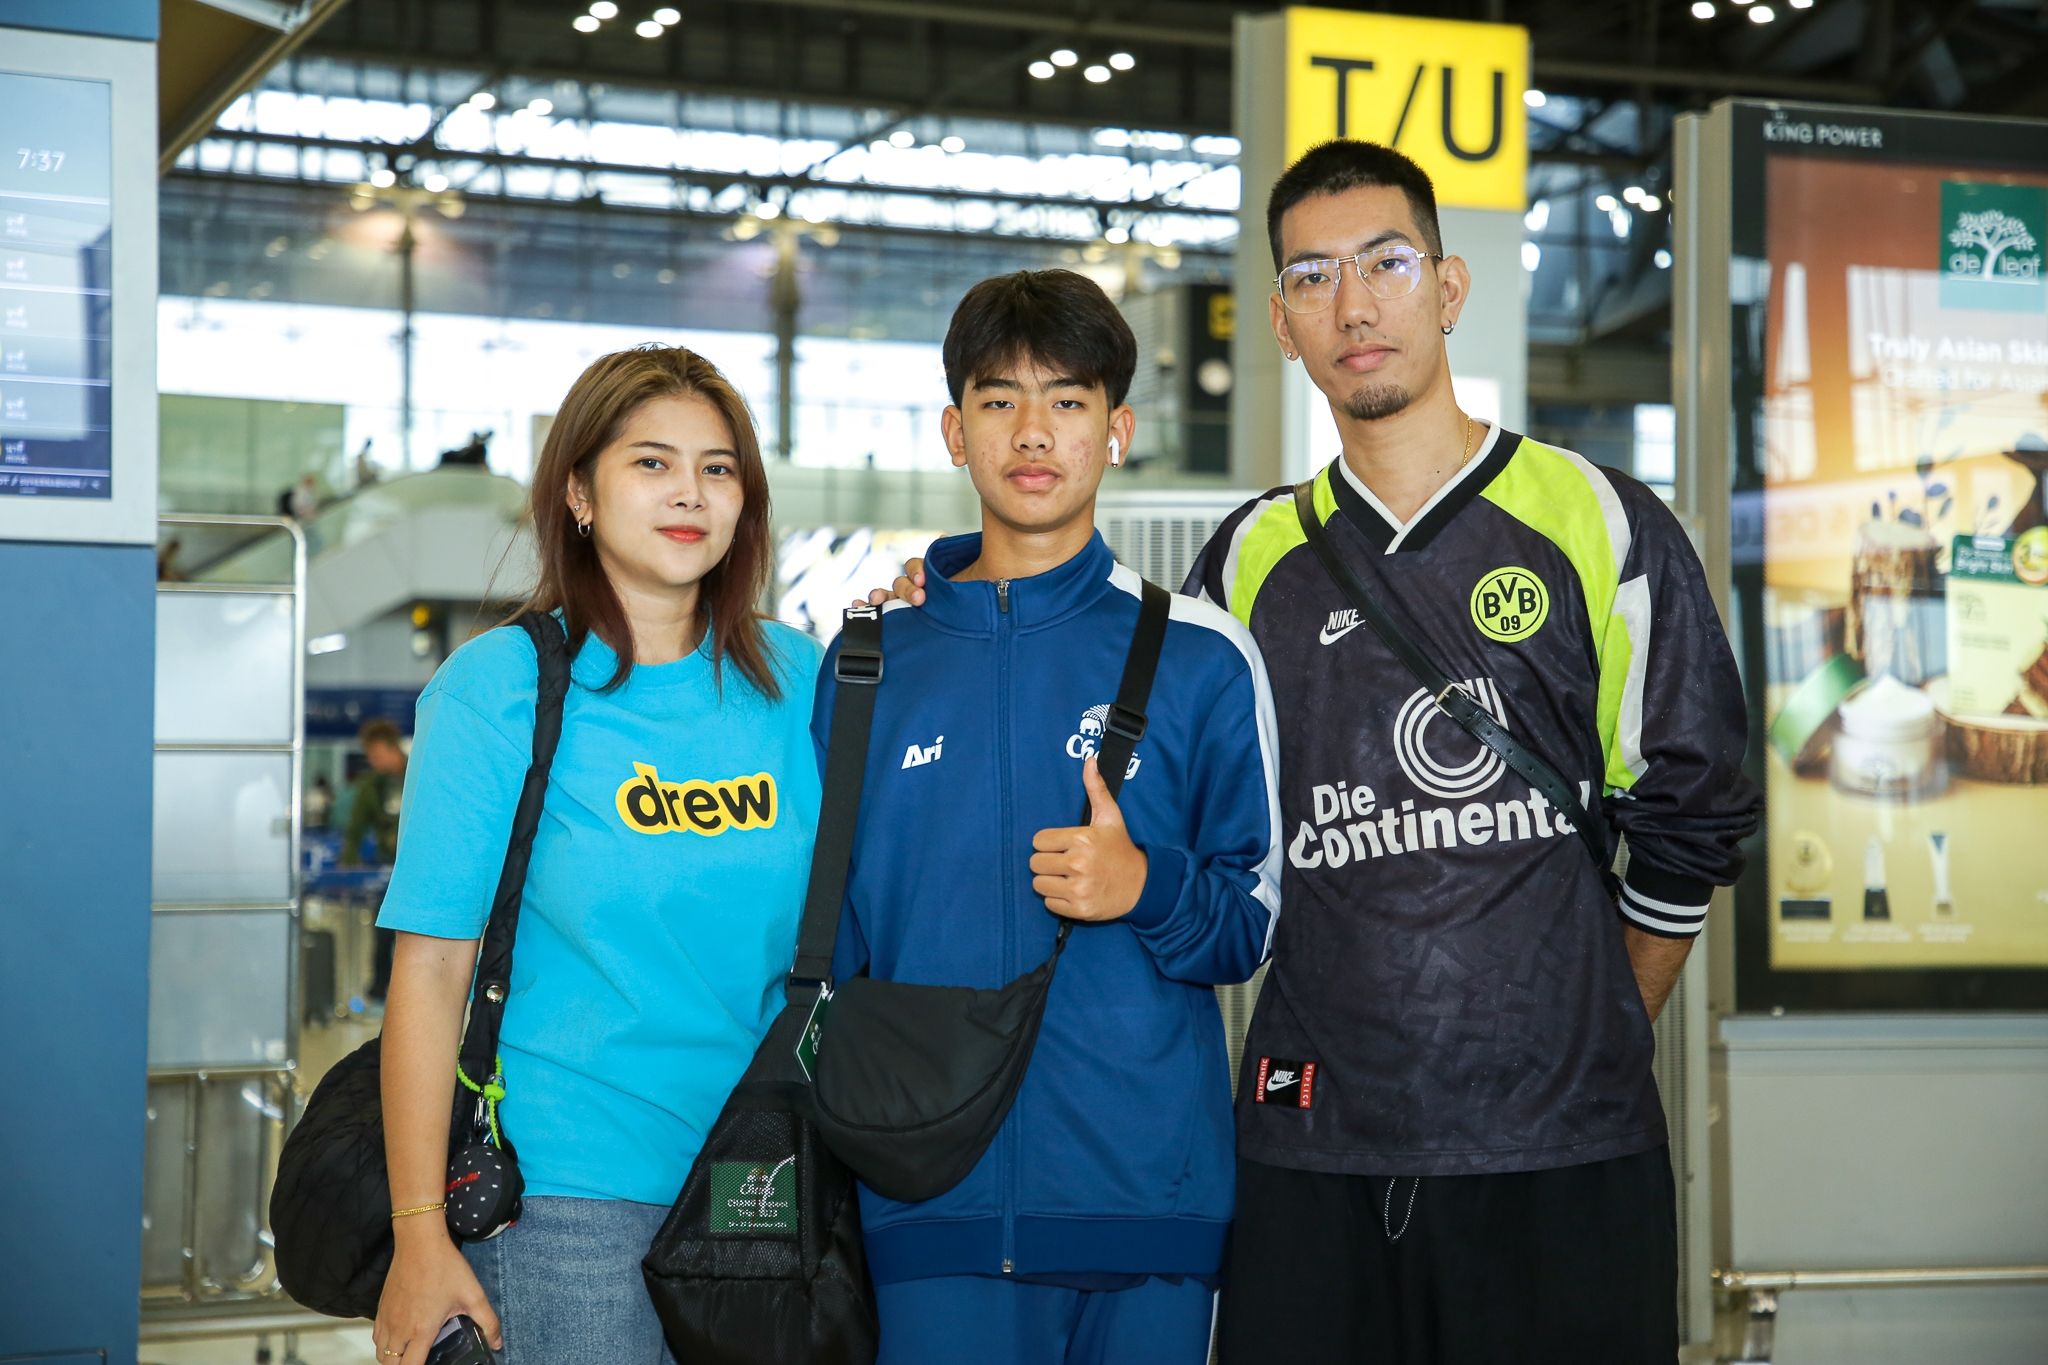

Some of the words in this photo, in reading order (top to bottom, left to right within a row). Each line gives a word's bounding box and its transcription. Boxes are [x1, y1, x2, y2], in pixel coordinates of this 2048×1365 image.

[1311, 56, 1503, 161] T/U
[1763, 121, 1813, 143] KING
[1816, 123, 1883, 148] POWER
[1949, 250, 1981, 275] de
[1999, 253, 2041, 281] leaf
[1483, 577, 1537, 619] BVB
[1327, 608, 1359, 631] NIKE
[1500, 615, 1521, 631] 09
[901, 735, 944, 770] Ari
[1066, 734, 1142, 780] Chg
[626, 774, 771, 831] drew
[1312, 780, 1376, 826] Die
[1273, 1070, 1295, 1083] NIKE
[1302, 1065, 1313, 1106] REPLICA
